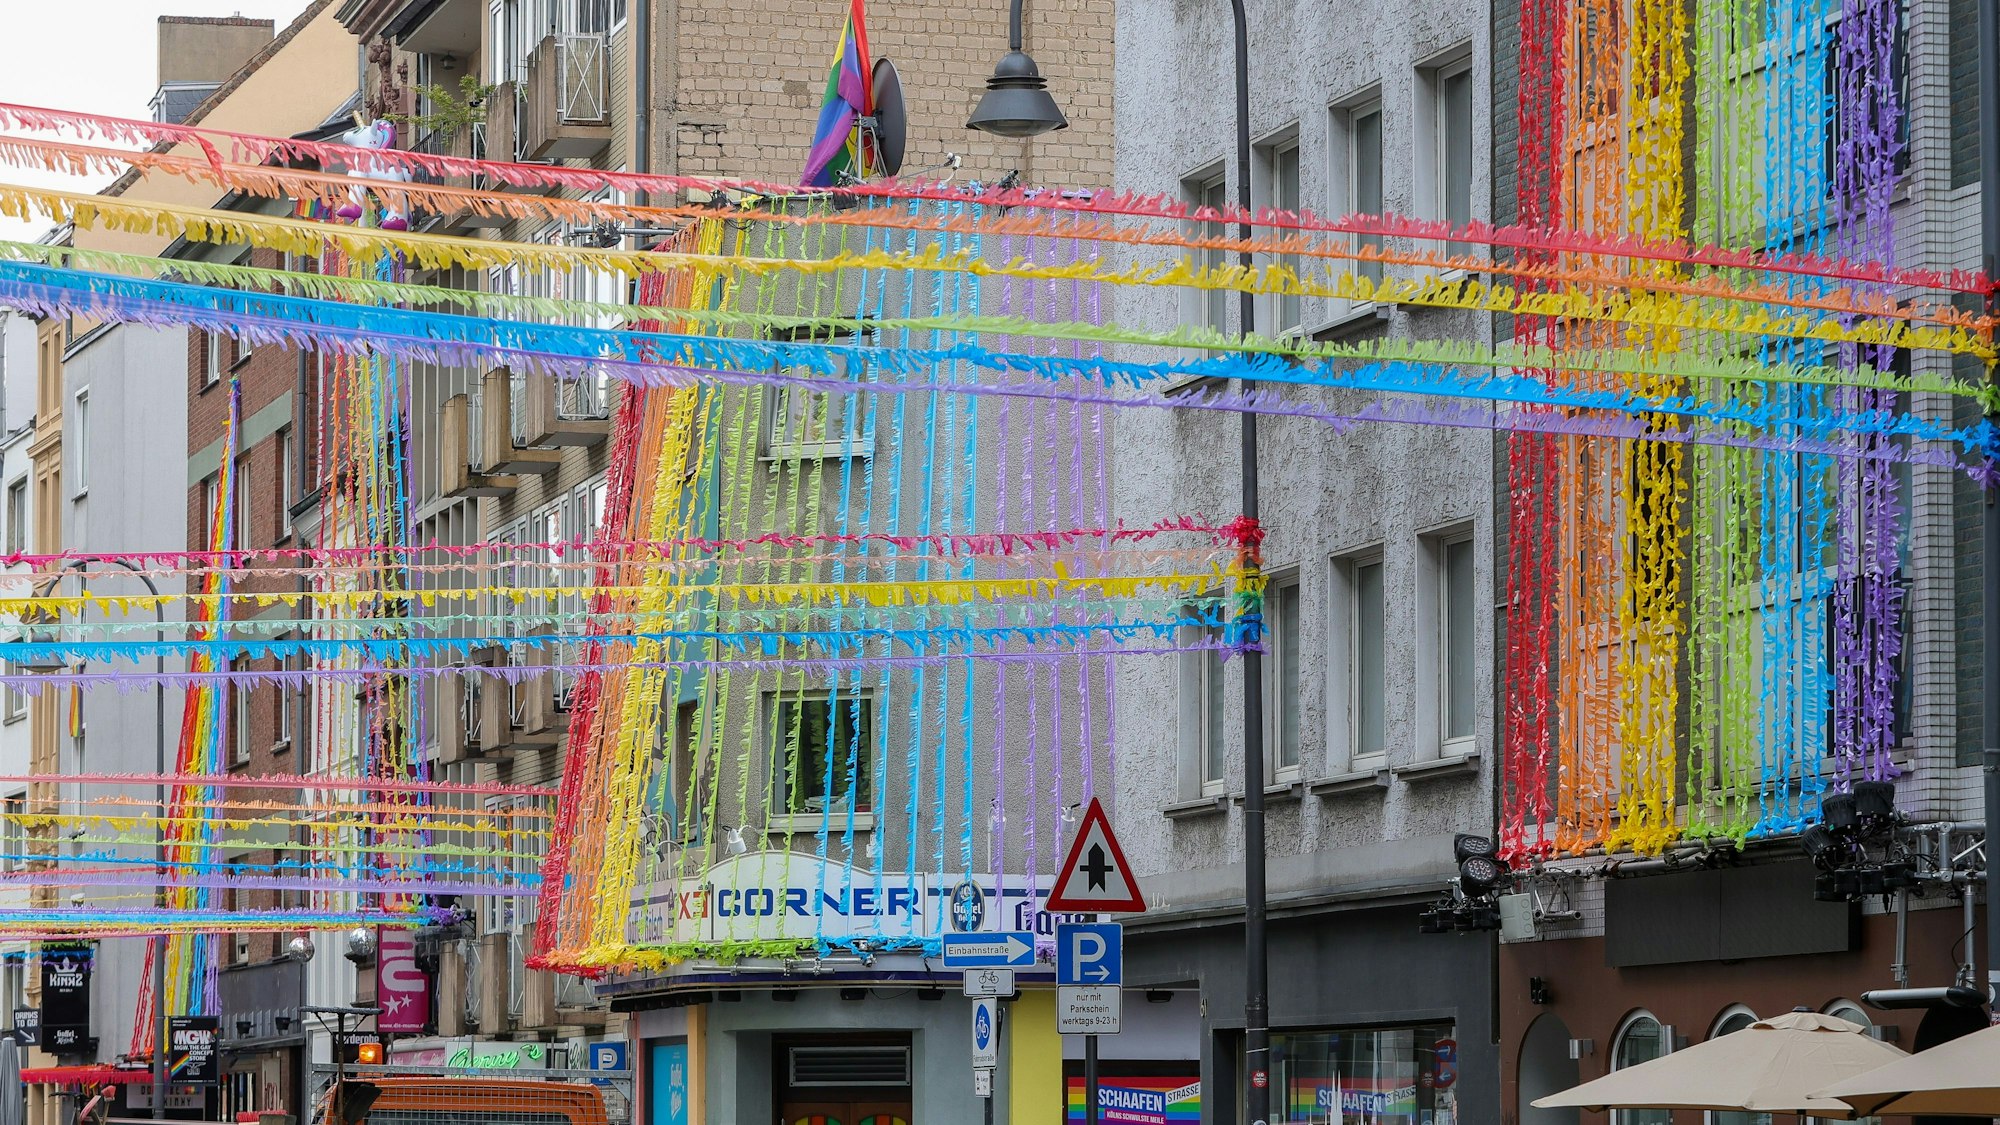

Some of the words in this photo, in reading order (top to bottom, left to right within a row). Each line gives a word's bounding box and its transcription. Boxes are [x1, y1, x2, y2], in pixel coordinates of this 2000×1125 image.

[718, 887, 922, 917] CORNER
[948, 946, 1009, 955] Einbahnstraße
[1073, 932, 1106, 981] P
[1090, 993, 1102, 1001] mit
[1070, 1005, 1110, 1013] Parkschein
[15, 1011, 38, 1020] DRINKS
[16, 1019, 25, 1027] TO
[27, 1019, 38, 1027] GO!
[1062, 1017, 1094, 1026] werktags
[1095, 1016, 1111, 1025] 9-23
[1098, 1089, 1162, 1112] SCHAAFEN
[1167, 1084, 1199, 1102] STRASSE
[1319, 1089, 1382, 1112] SCAAFEN
[1106, 1110, 1122, 1120] KÖLNS
[1122, 1112, 1149, 1123] SCHWULSTE
[1150, 1116, 1164, 1125] MEILE
